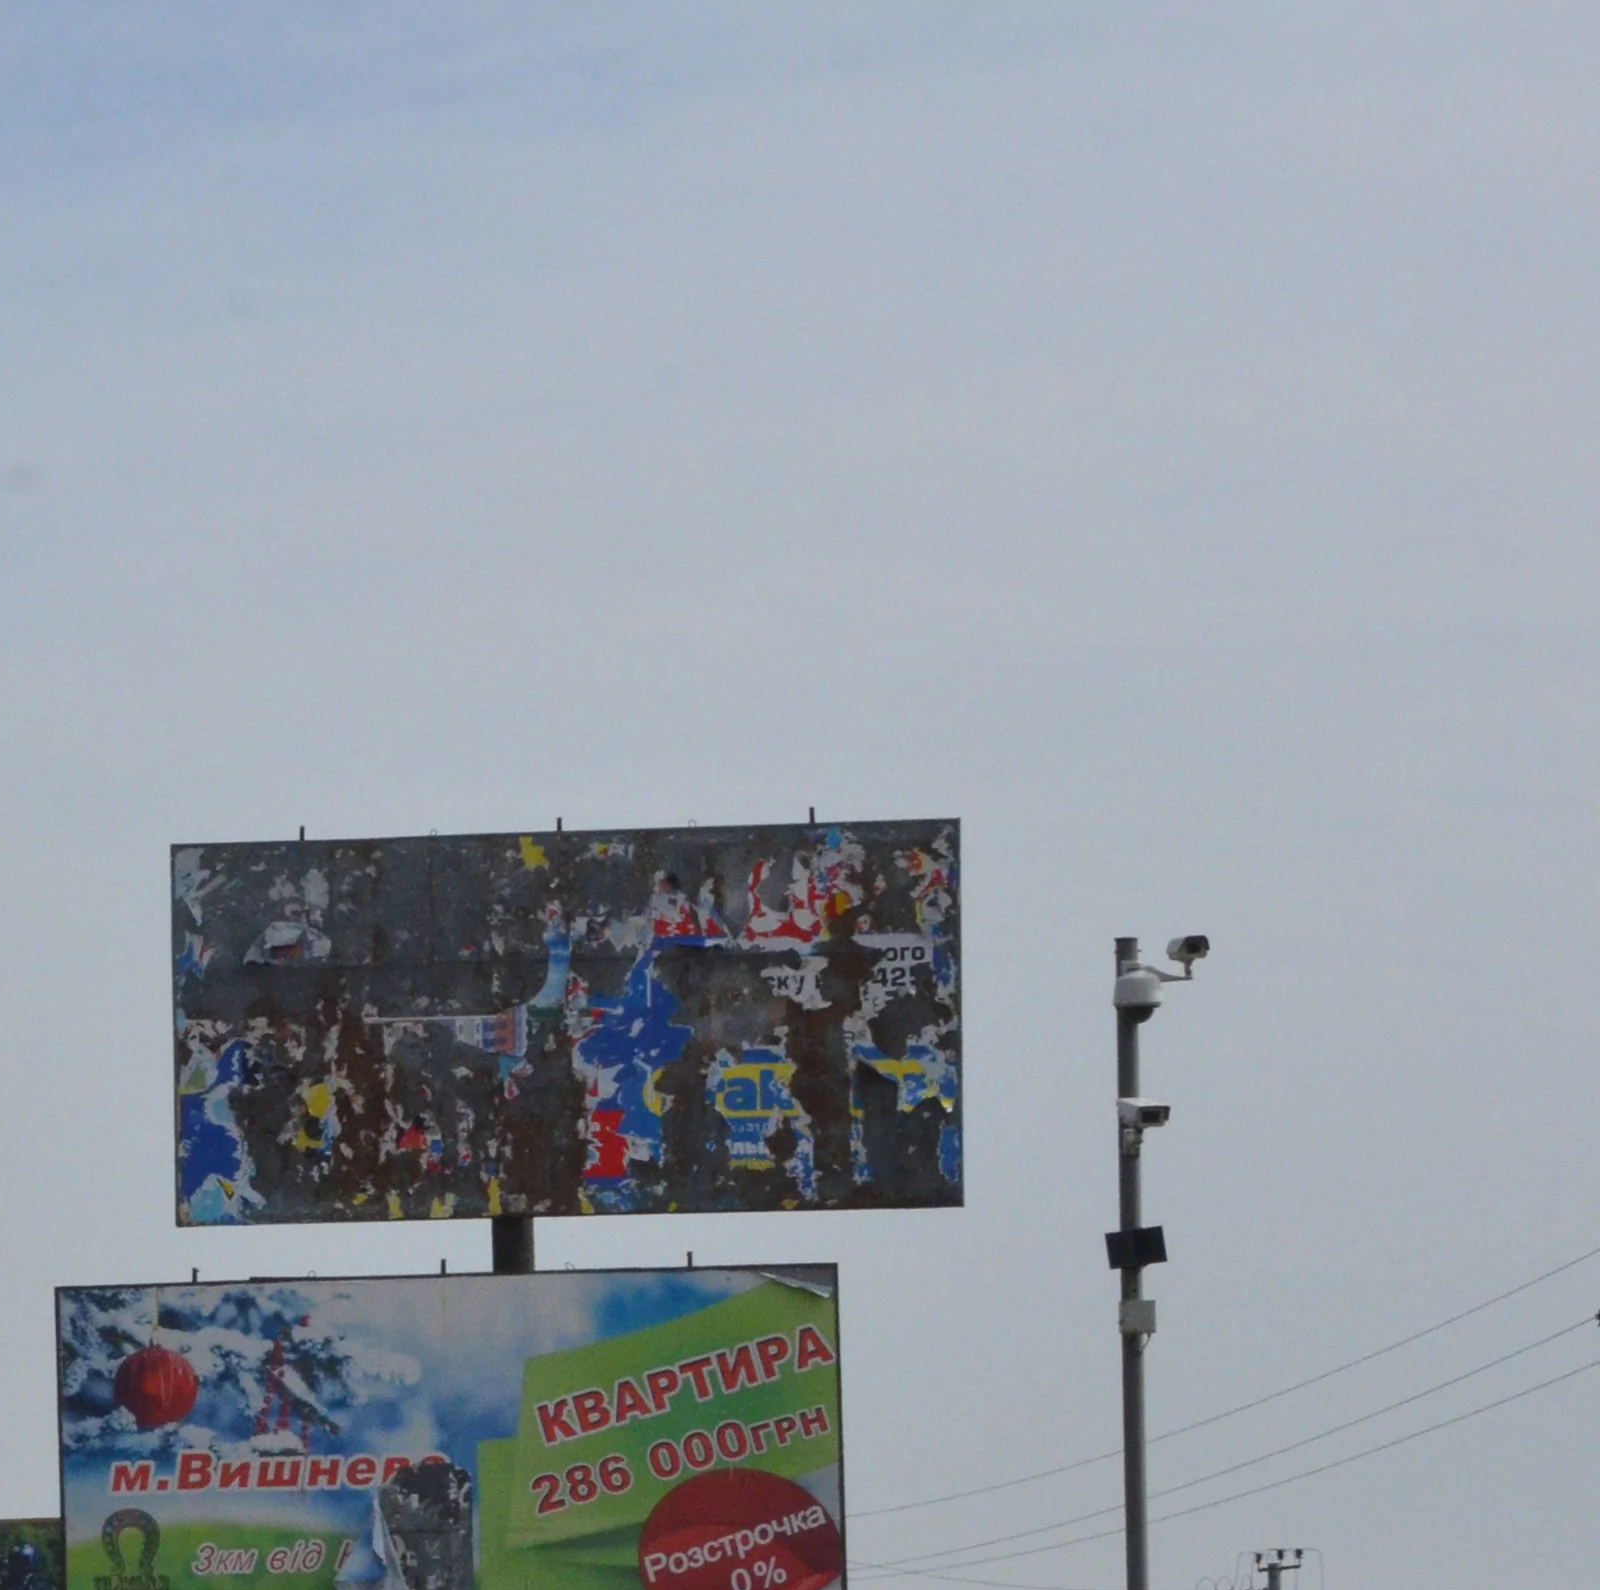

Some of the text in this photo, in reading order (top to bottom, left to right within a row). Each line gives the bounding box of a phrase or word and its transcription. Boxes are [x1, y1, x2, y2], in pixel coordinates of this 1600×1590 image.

[536, 1325, 835, 1445] КВАРТИРА
[531, 1455, 632, 1515] 286
[267, 1540, 324, 1573] від
[644, 1505, 827, 1583] Розстрочка
